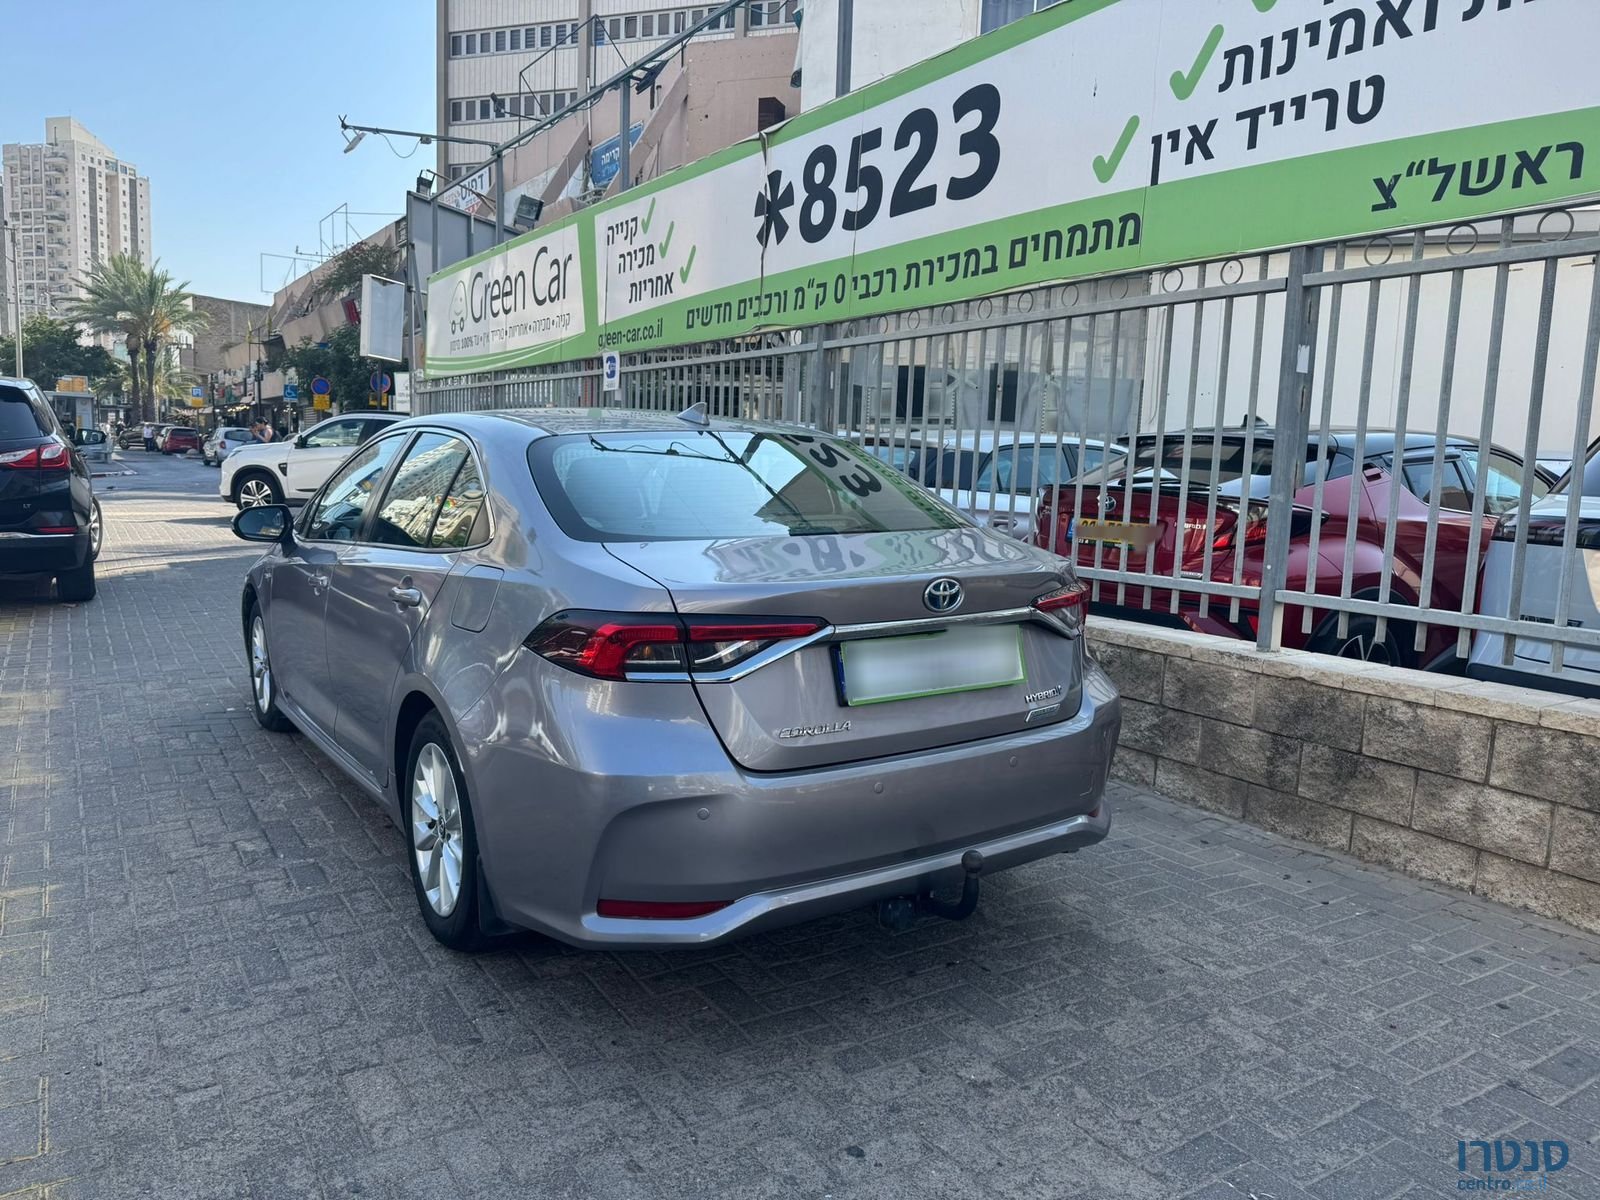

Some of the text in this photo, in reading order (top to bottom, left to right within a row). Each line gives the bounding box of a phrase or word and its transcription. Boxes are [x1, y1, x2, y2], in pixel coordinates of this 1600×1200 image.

[1150, 74, 1386, 187] טרייד אין
[607, 216, 638, 246] קנייה
[1008, 212, 1142, 269] מתמחים
[618, 243, 655, 274] מכירה
[903, 244, 999, 292] במכירת
[470, 246, 573, 323] Green Car
[629, 271, 674, 304] אחריות
[834, 273, 846, 304] 0
[852, 267, 897, 300] רכבי
[686, 301, 732, 330] חדשים
[737, 289, 788, 321] ורכבים
[778, 720, 852, 739] COROLLA
